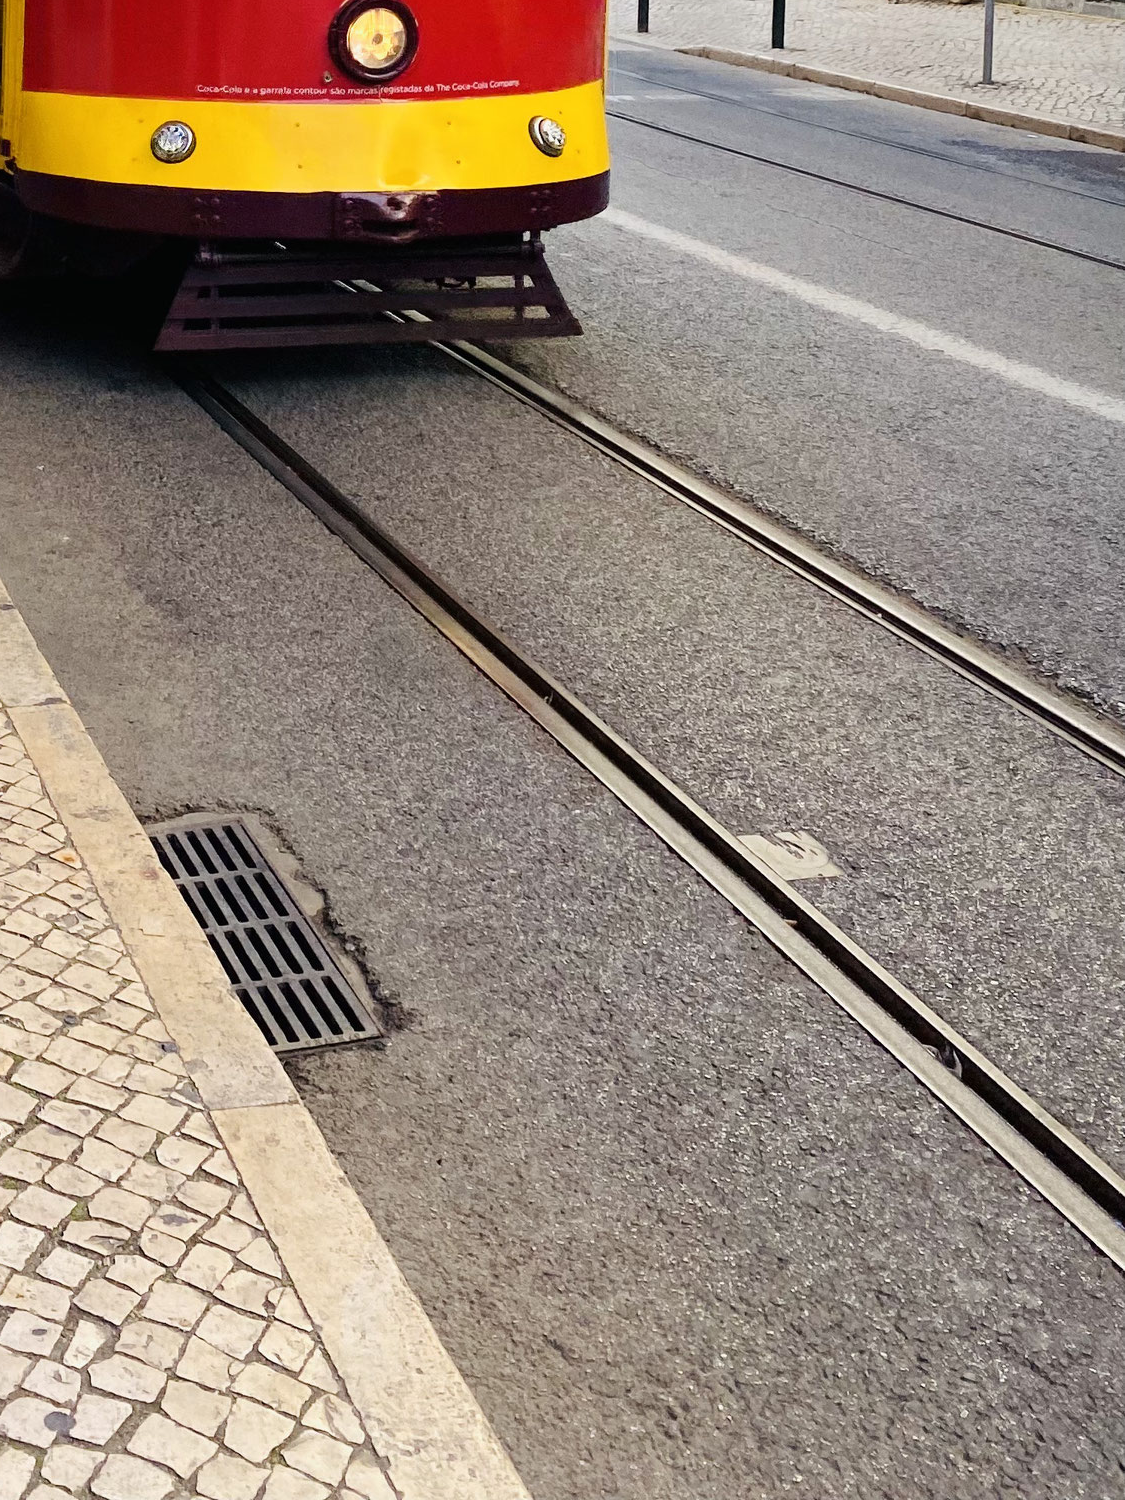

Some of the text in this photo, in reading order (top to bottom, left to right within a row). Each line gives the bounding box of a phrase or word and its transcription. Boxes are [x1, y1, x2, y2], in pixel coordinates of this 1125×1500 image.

[294, 86, 326, 95] contour
[330, 86, 346, 95] são
[347, 87, 378, 96] marcas
[380, 84, 422, 96] registadas
[436, 83, 451, 92] The
